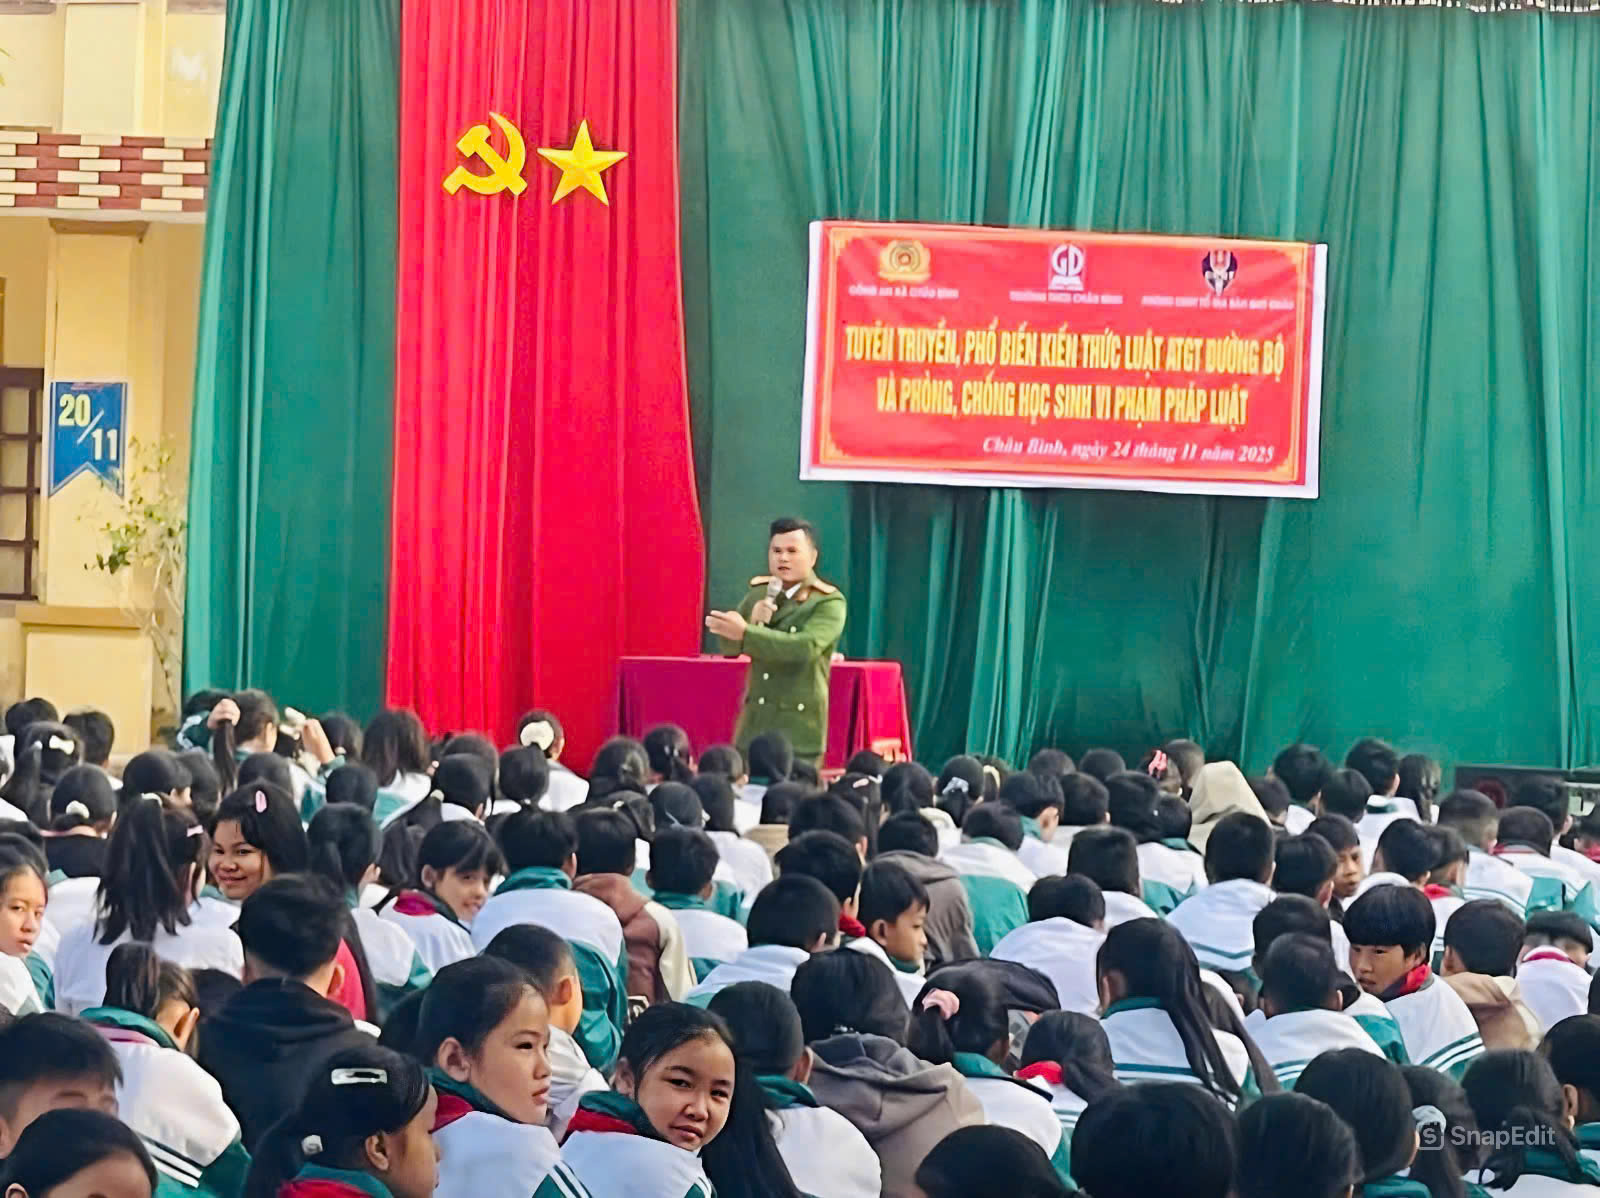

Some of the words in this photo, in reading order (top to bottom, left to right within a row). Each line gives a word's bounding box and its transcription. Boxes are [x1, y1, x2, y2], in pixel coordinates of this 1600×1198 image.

[1000, 321, 1037, 367] BIẾN
[1040, 322, 1079, 368] KIẾN
[1082, 327, 1121, 369] THỨC
[1125, 328, 1164, 380] LUẬT
[1165, 336, 1202, 372] ATGT
[1263, 332, 1284, 382] BỘ
[877, 370, 897, 412] VÀ
[899, 369, 957, 417] PHÒNG,
[961, 370, 1015, 416] CHỐNG
[1018, 382, 1050, 425] HỌC
[1053, 383, 1092, 419] SINH
[1095, 385, 1111, 419] VI
[1113, 385, 1161, 429] PHẠM
[1163, 381, 1207, 423] PHÁP
[1210, 383, 1248, 432] LUẬT
[1111, 441, 1131, 457] 24
[1181, 442, 1197, 460] 11
